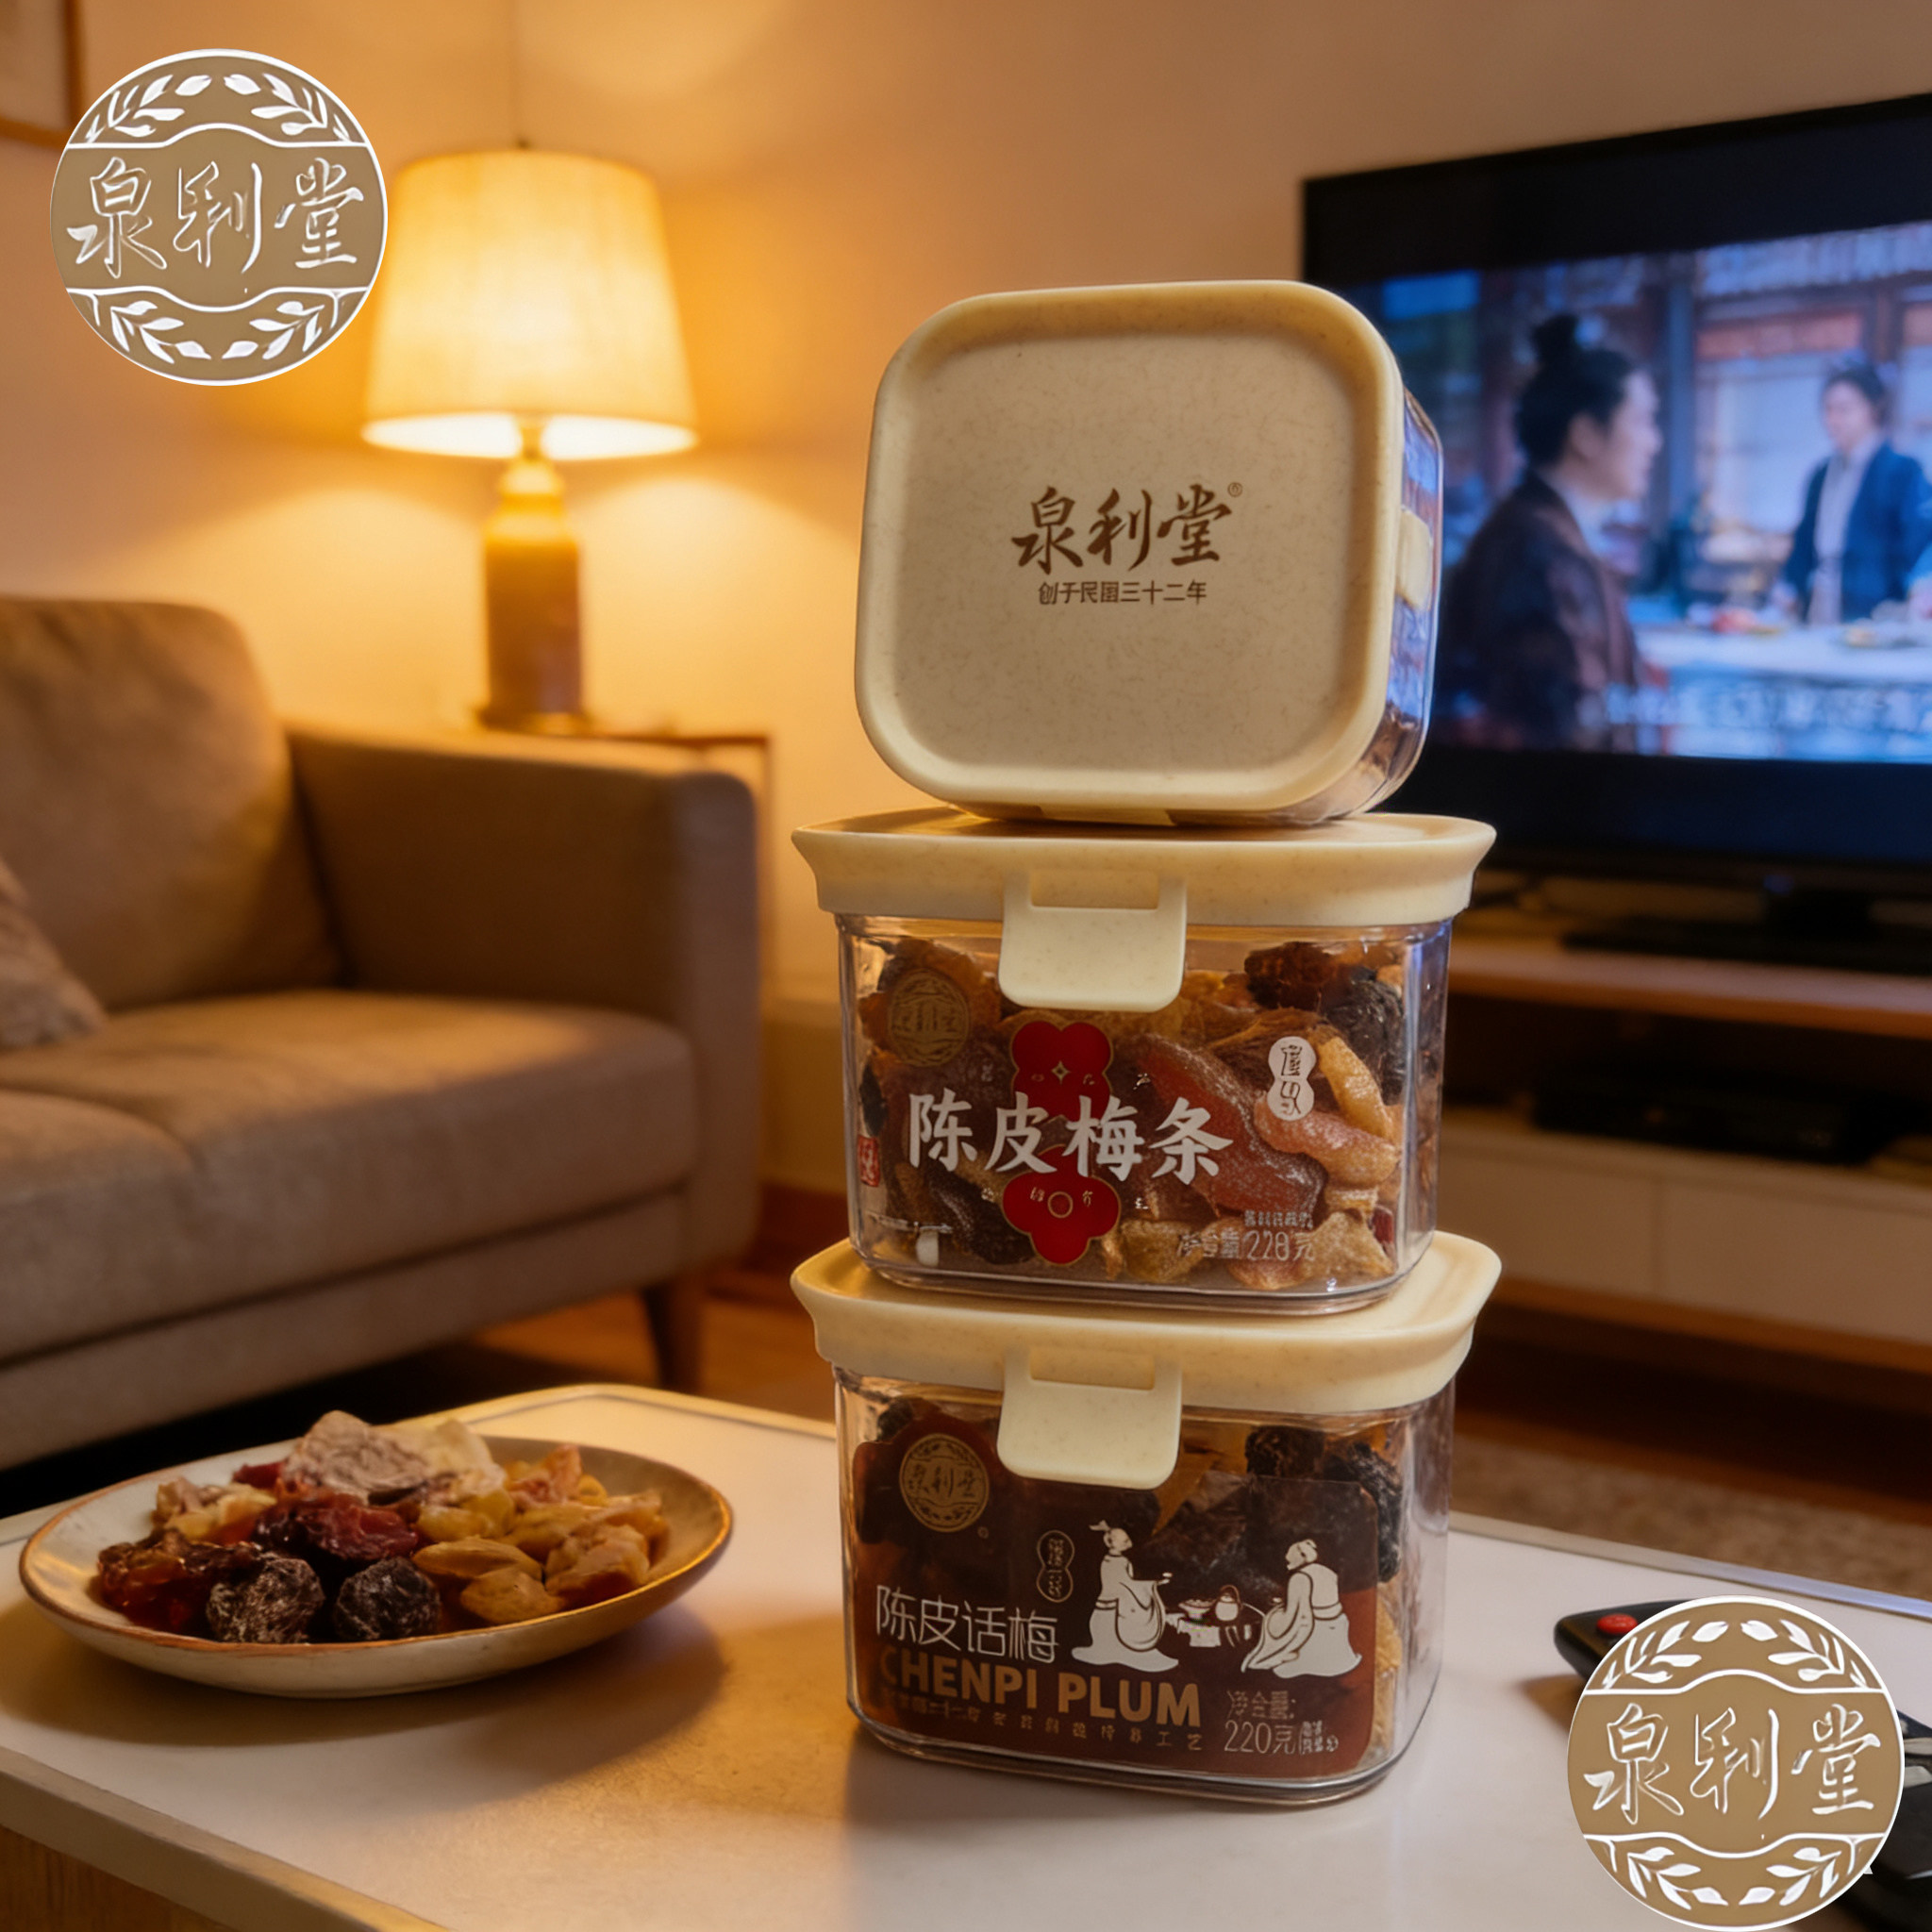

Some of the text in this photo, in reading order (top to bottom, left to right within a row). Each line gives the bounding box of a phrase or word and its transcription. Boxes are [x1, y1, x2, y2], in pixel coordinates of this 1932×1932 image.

[1011, 483, 1232, 575] 泉利堂
[1039, 579, 1208, 605] 创于民国三十二年
[908, 1088, 1234, 1186] 陈皮梅条
[876, 1584, 1059, 1664] 陈皮话梅
[880, 1645, 1038, 1709] CHENPI
[1058, 1672, 1202, 1727] PLUM
